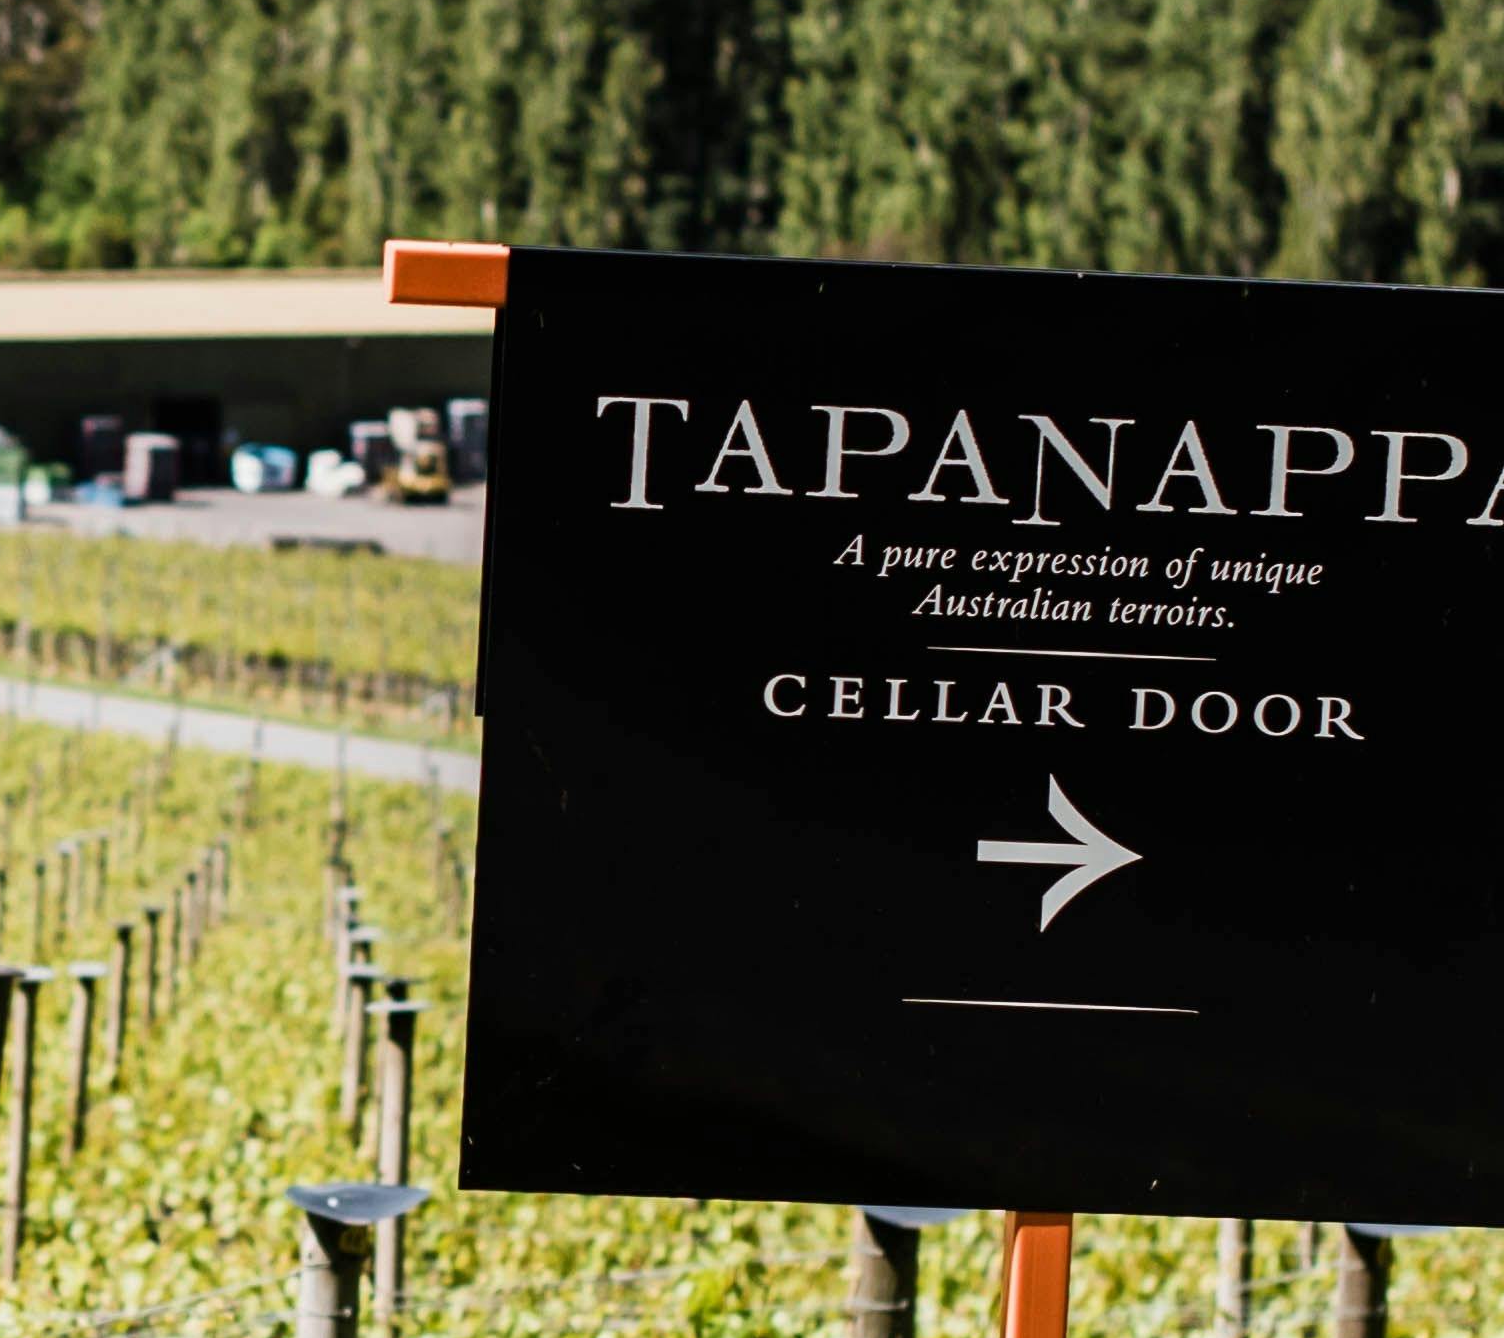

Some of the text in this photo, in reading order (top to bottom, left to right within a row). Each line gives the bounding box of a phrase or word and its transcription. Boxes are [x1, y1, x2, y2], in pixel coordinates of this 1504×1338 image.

[832, 534, 1324, 594] A pure expression of unique
[911, 583, 1236, 629] Australian terroirs.
[763, 673, 1365, 741] CELLAR DOOR
